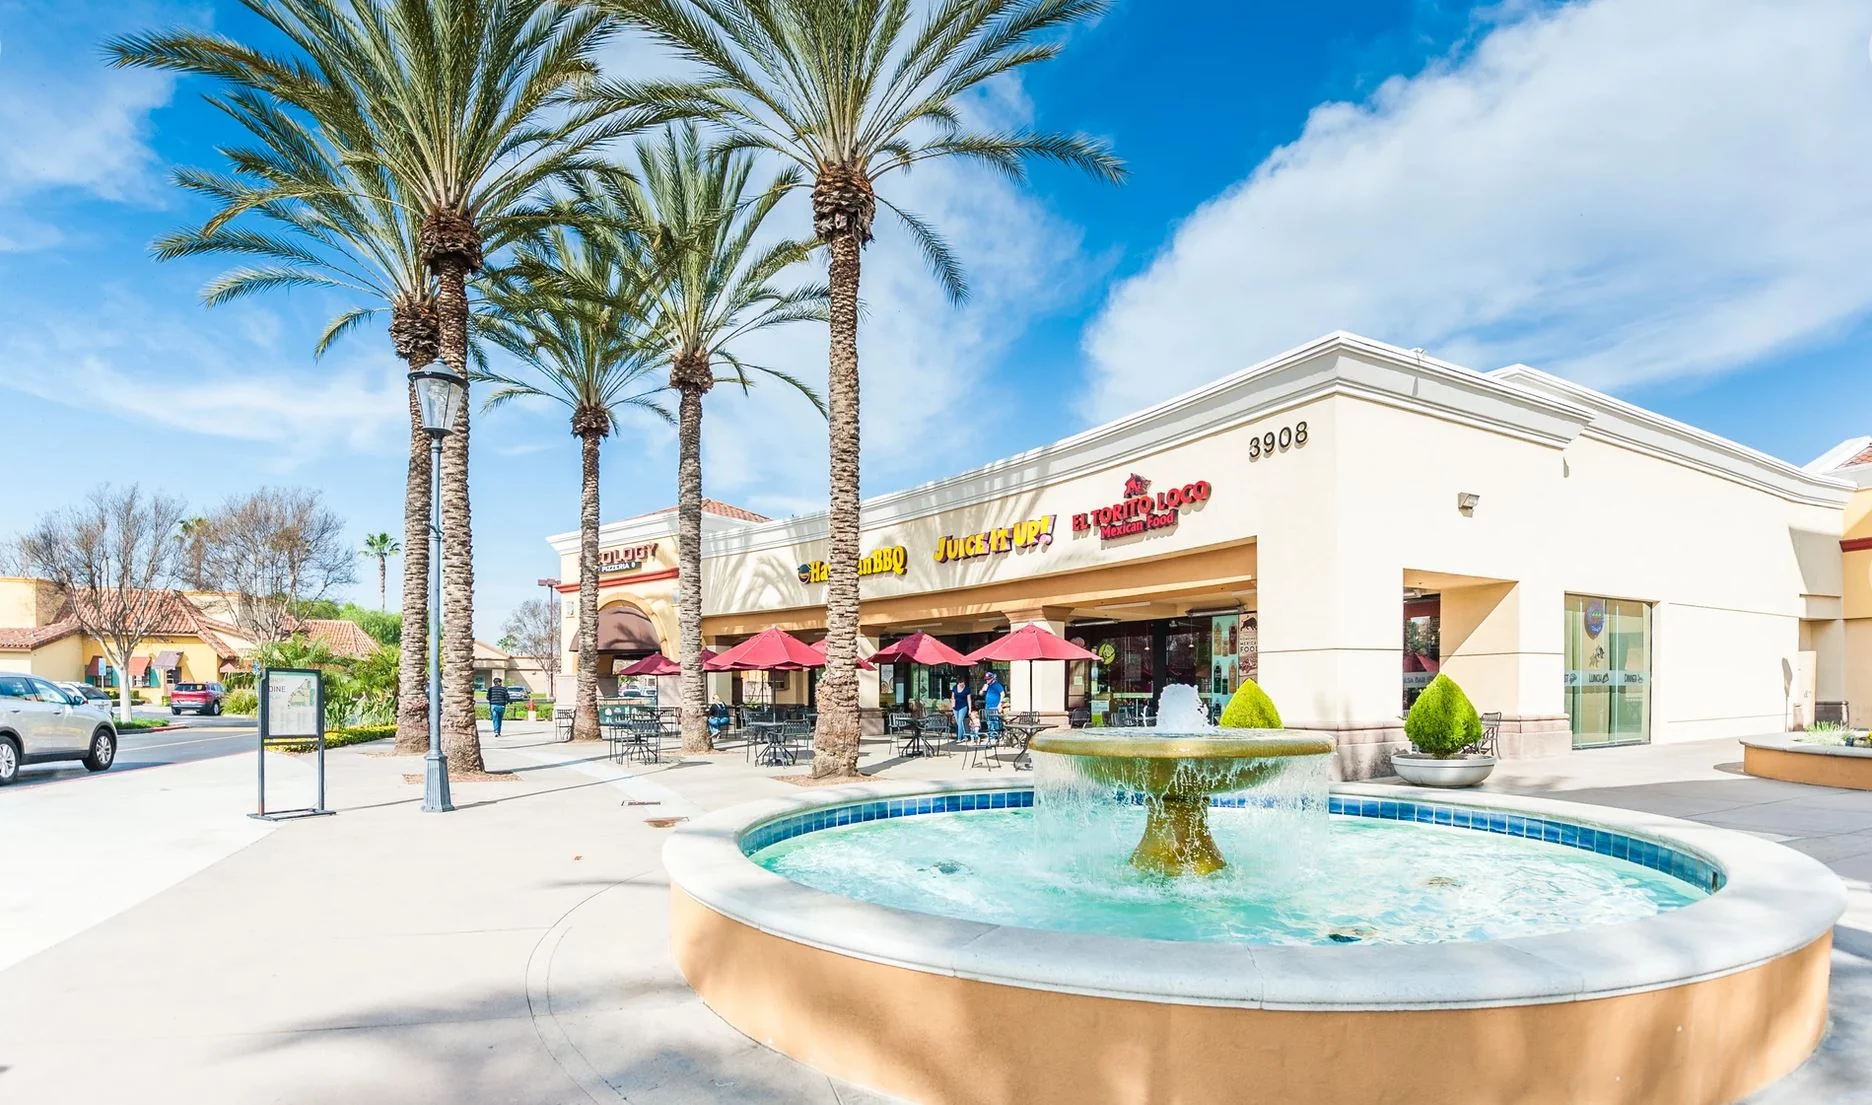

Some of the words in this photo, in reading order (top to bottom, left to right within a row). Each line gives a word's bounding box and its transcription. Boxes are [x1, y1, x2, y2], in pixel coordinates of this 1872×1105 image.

[1249, 421, 1308, 457] 3908
[1072, 513, 1090, 531] EL
[1091, 496, 1154, 525] TORITO
[1157, 480, 1211, 510] LOCO
[934, 533, 989, 563] JUICE
[990, 527, 1011, 553] IT
[1013, 514, 1057, 547] UP!
[1101, 520, 1144, 540] Mexican
[1146, 509, 1178, 529] Food
[873, 545, 908, 575] BBQ
[269, 685, 286, 693] DINE
